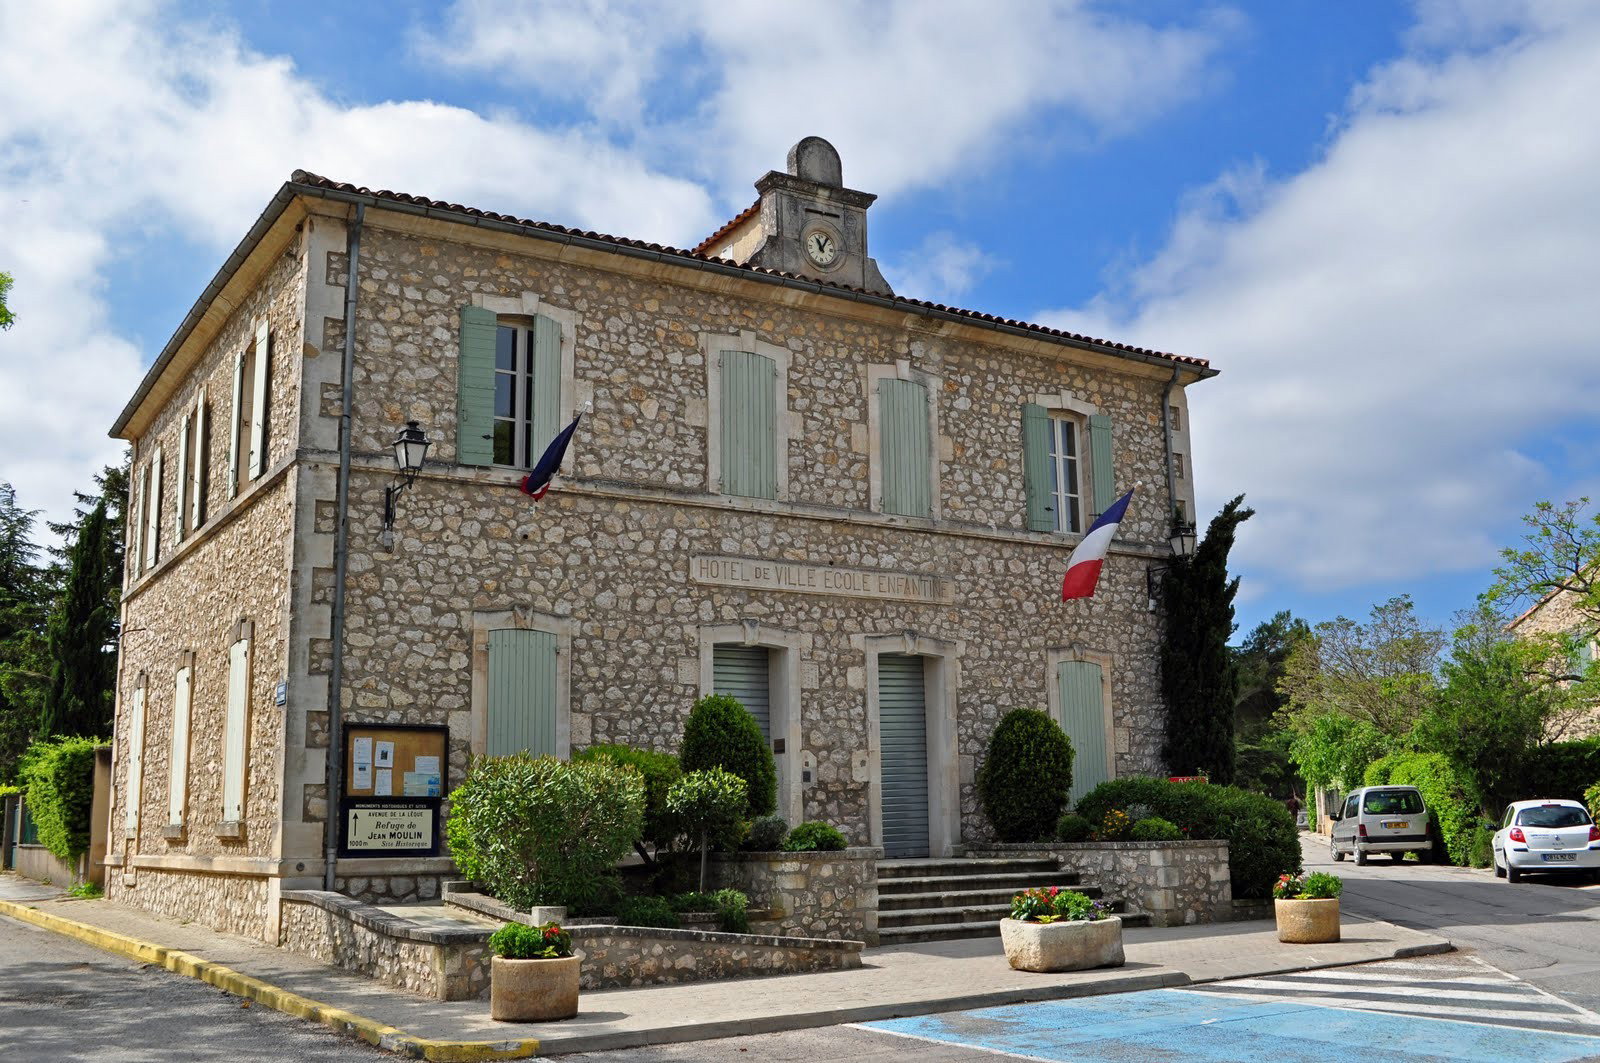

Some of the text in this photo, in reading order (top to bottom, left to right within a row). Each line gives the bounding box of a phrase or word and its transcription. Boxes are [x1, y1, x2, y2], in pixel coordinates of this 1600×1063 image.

[699, 558, 949, 598] HOTEL DE VILLE ECOLE ENFANTINE
[375, 821, 417, 831] Refuge de
[389, 831, 423, 840] MOULIN
[395, 840, 428, 848] Historique
